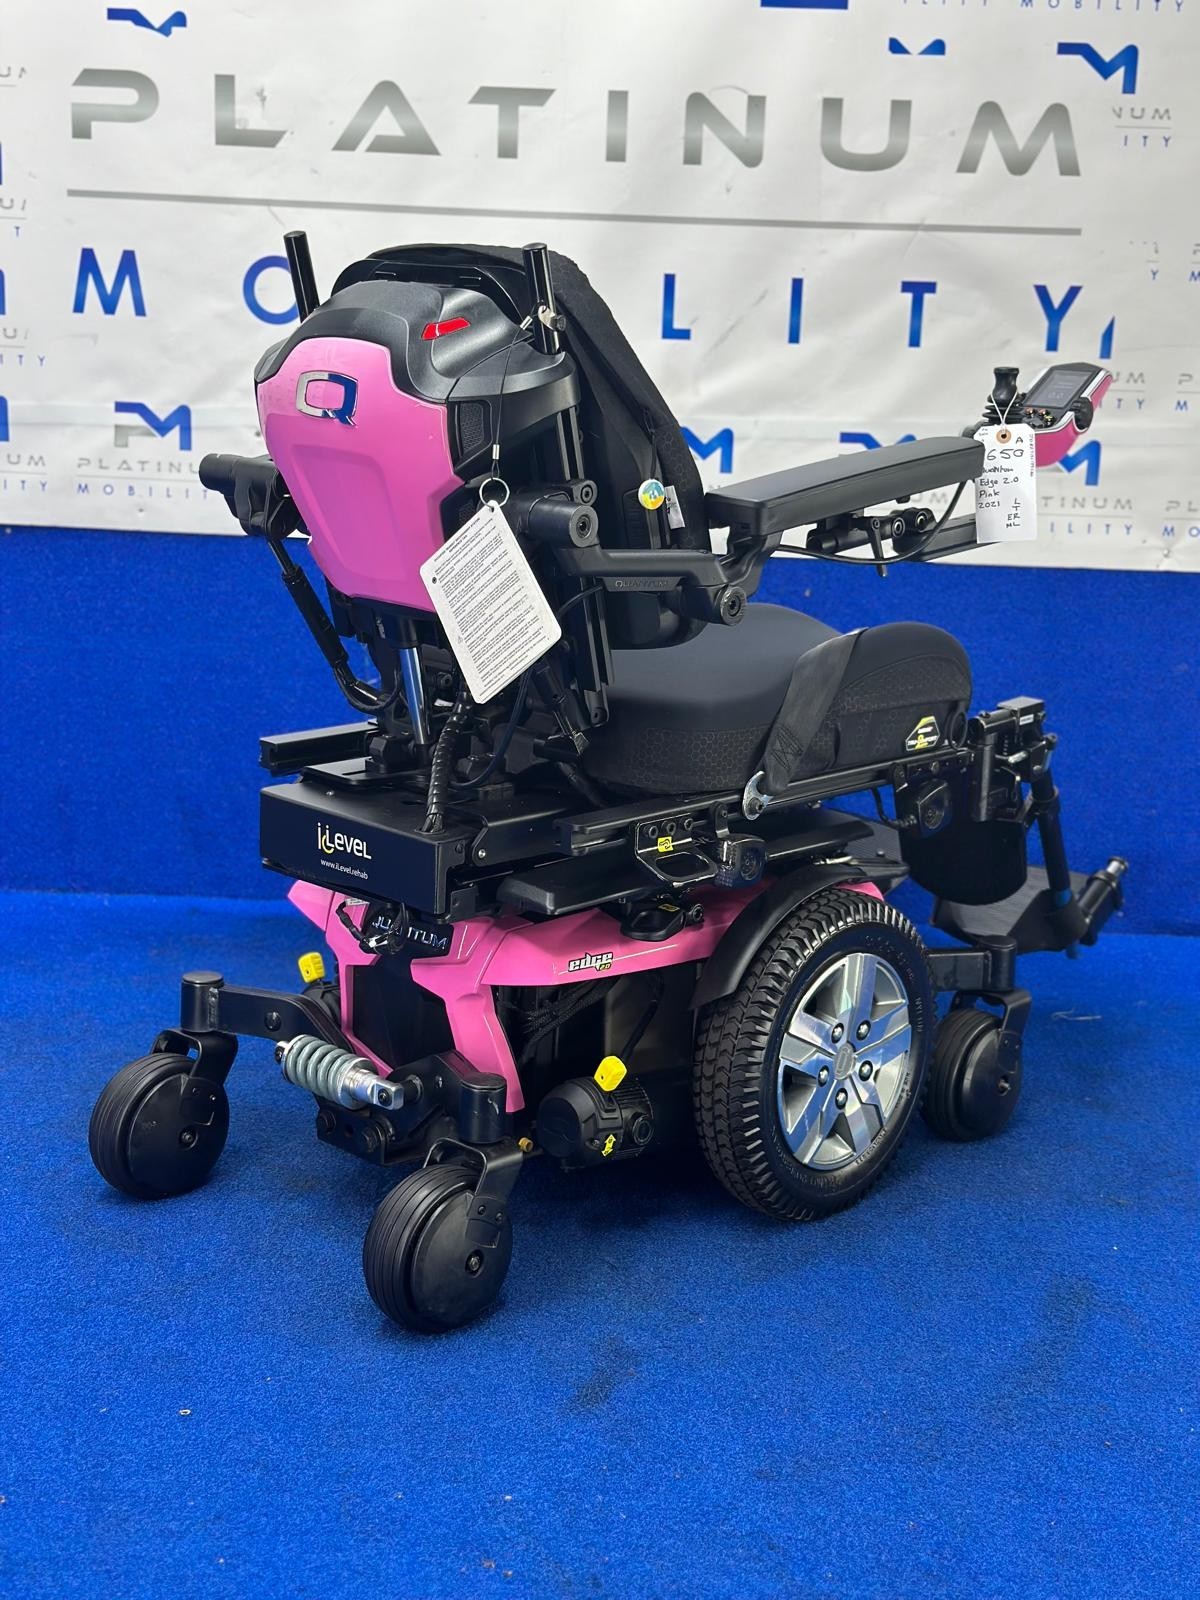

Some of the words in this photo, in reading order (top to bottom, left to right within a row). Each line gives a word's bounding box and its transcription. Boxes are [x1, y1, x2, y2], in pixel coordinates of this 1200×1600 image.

[71, 67, 1081, 177] PLATINUM
[72, 246, 1084, 352] MOLITY
[77, 457, 199, 474] PLATINU
[979, 478, 999, 488] Edge
[1002, 476, 1019, 484] 2.0
[77, 483, 208, 499] MOBILIT
[979, 489, 1000, 498] Pink
[978, 500, 1000, 509] 2021
[1041, 495, 1134, 511] TINUM
[1050, 522, 1134, 535] ILITY
[569, 952, 613, 972] edge
